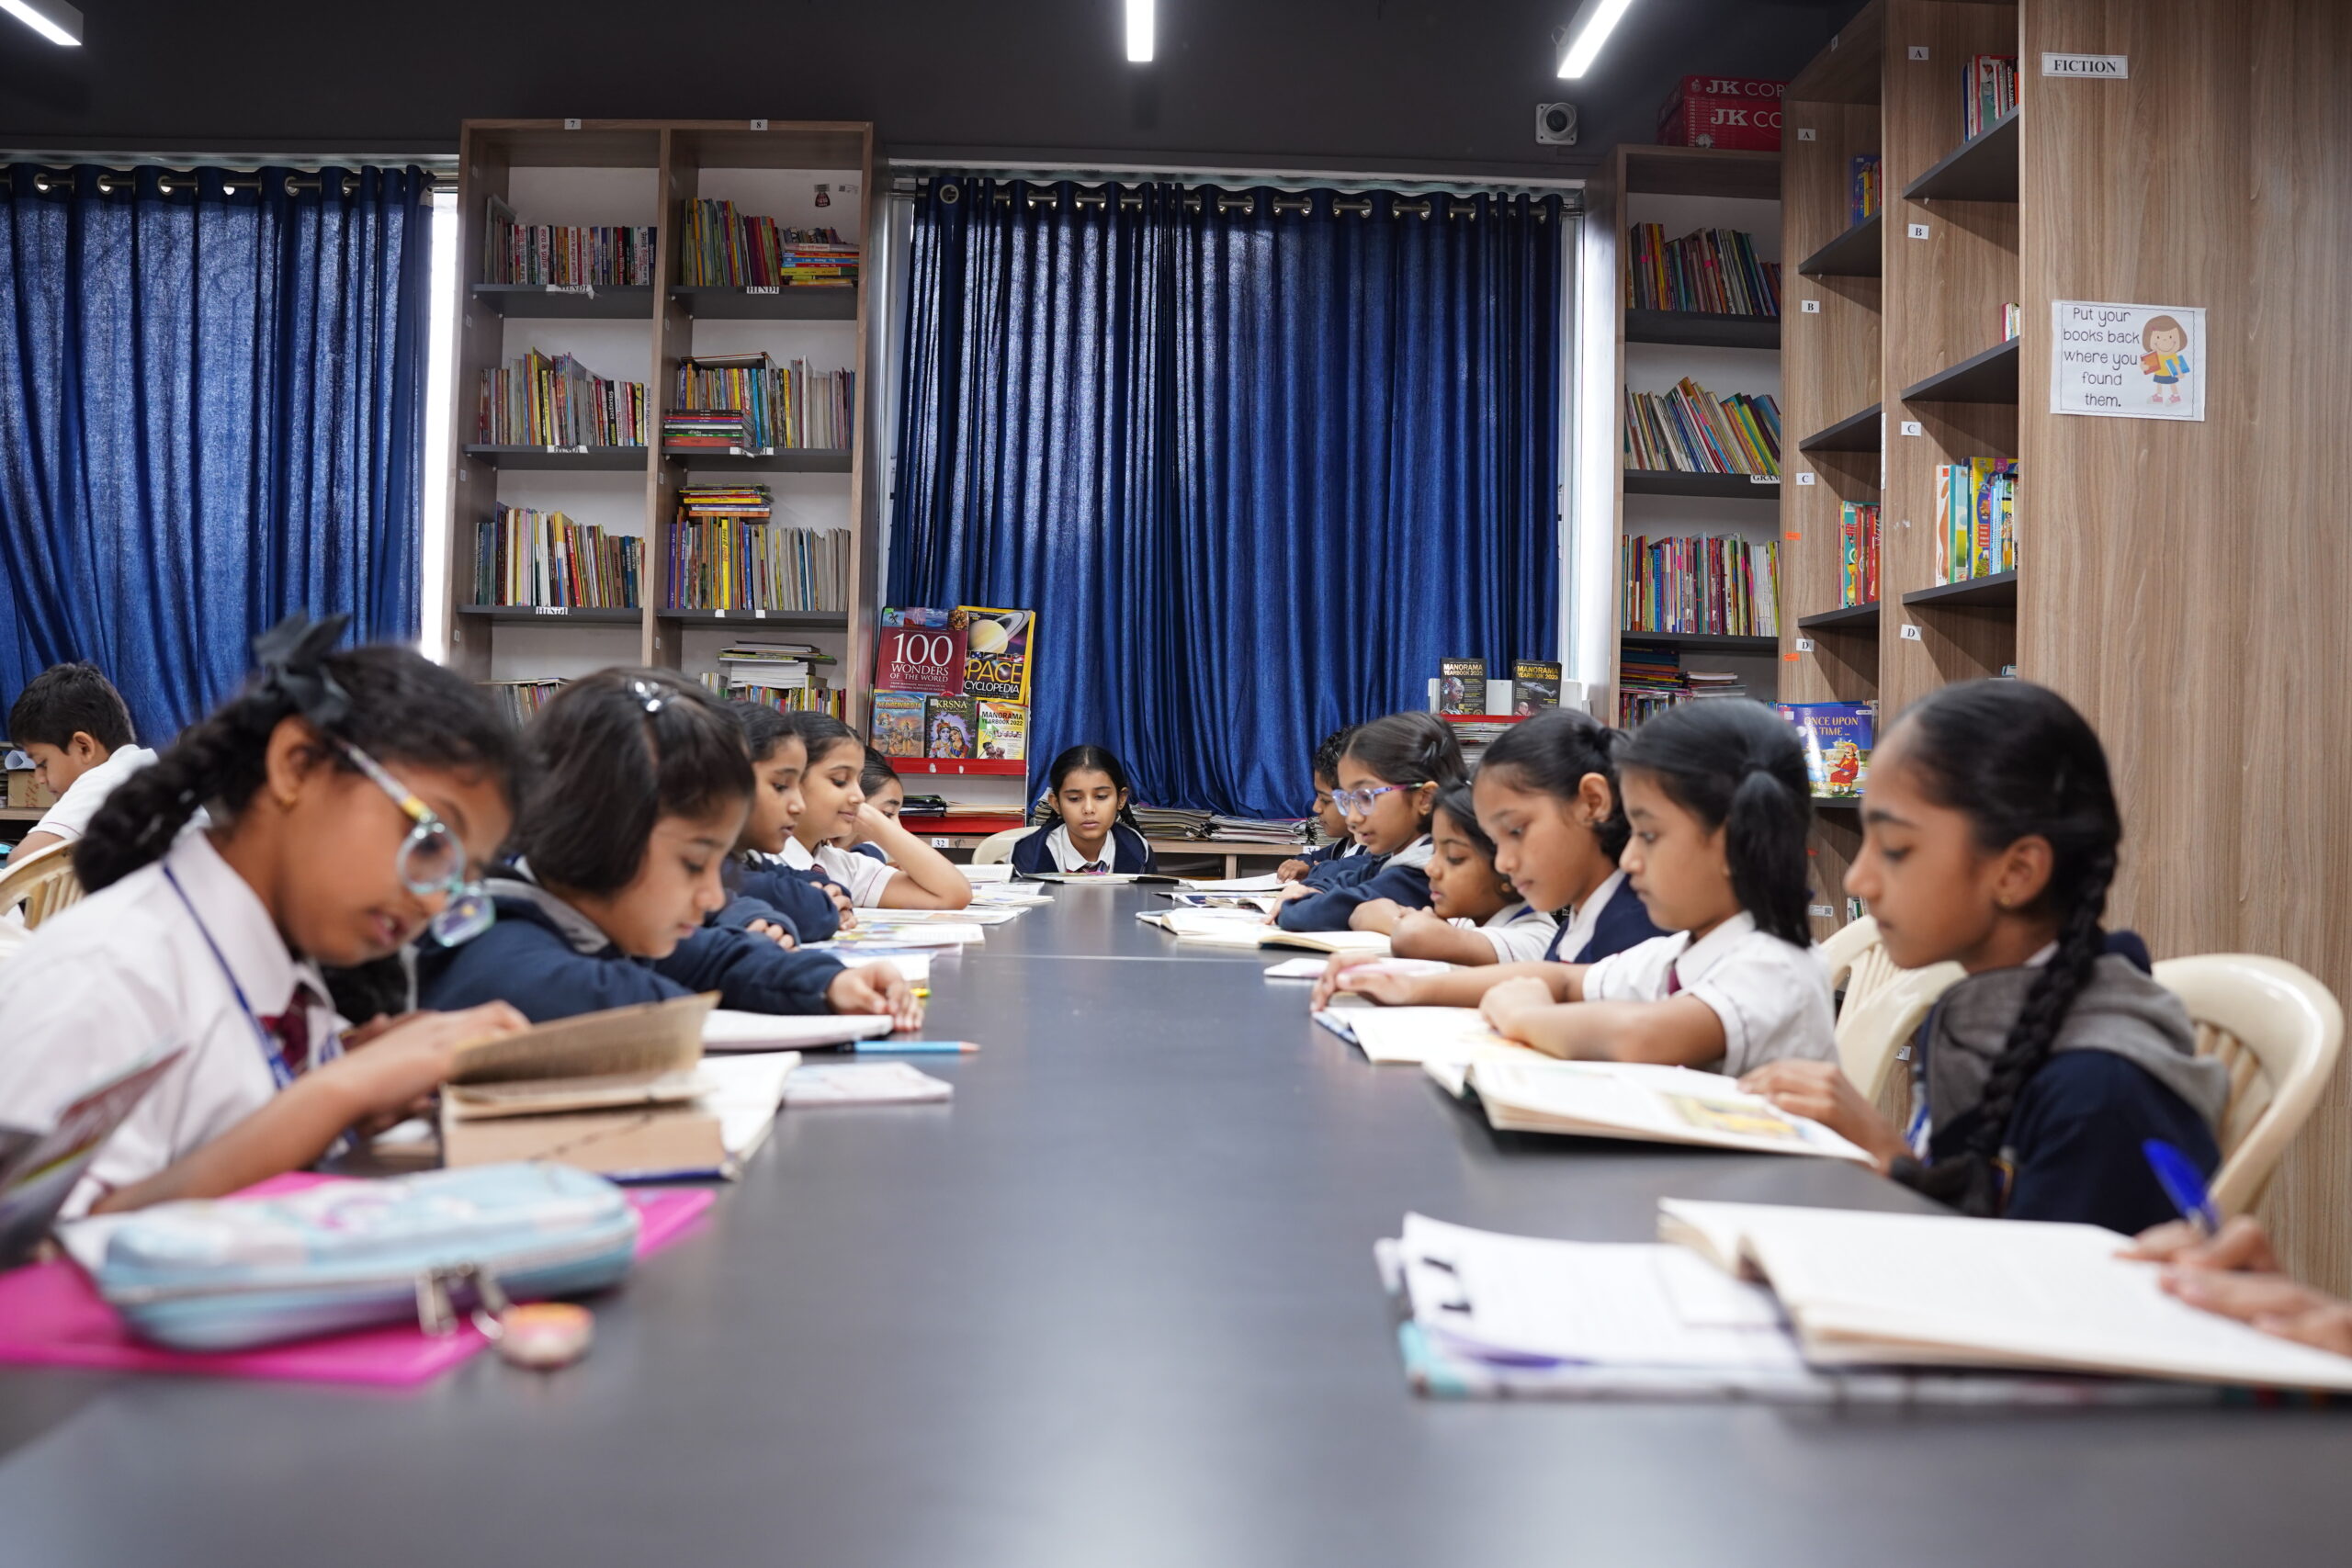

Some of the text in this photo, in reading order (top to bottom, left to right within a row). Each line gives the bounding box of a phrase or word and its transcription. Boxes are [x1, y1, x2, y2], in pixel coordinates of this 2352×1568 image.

[1915, 50, 1923, 58] A
[2053, 59, 2117, 73] FICTION
[1705, 79, 1741, 95] JK
[1710, 108, 1749, 126] JK
[1915, 227, 1923, 236] B
[1807, 302, 1815, 310] B
[2073, 307, 2132, 328] Put your
[2063, 328, 2141, 344] books back
[2064, 349, 2138, 371] where you
[2081, 371, 2122, 386] found
[2085, 392, 2121, 408] them.
[1907, 424, 1917, 434] C
[1802, 475, 1809, 483] C
[1907, 627, 1916, 637] D
[891, 633, 954, 667] 100
[1802, 641, 1810, 649] D
[891, 663, 950, 677] WONDERS
[964, 659, 1023, 685] PACE
[1517, 665, 1559, 674] MANORAMA
[921, 674, 949, 682] WORLD
[935, 699, 967, 709] KRSNA
[981, 711, 1023, 721] MANORAMA
[1804, 716, 1859, 726] ONCE UPON
[1819, 727, 1843, 736] TIME
[935, 839, 945, 848] 32
